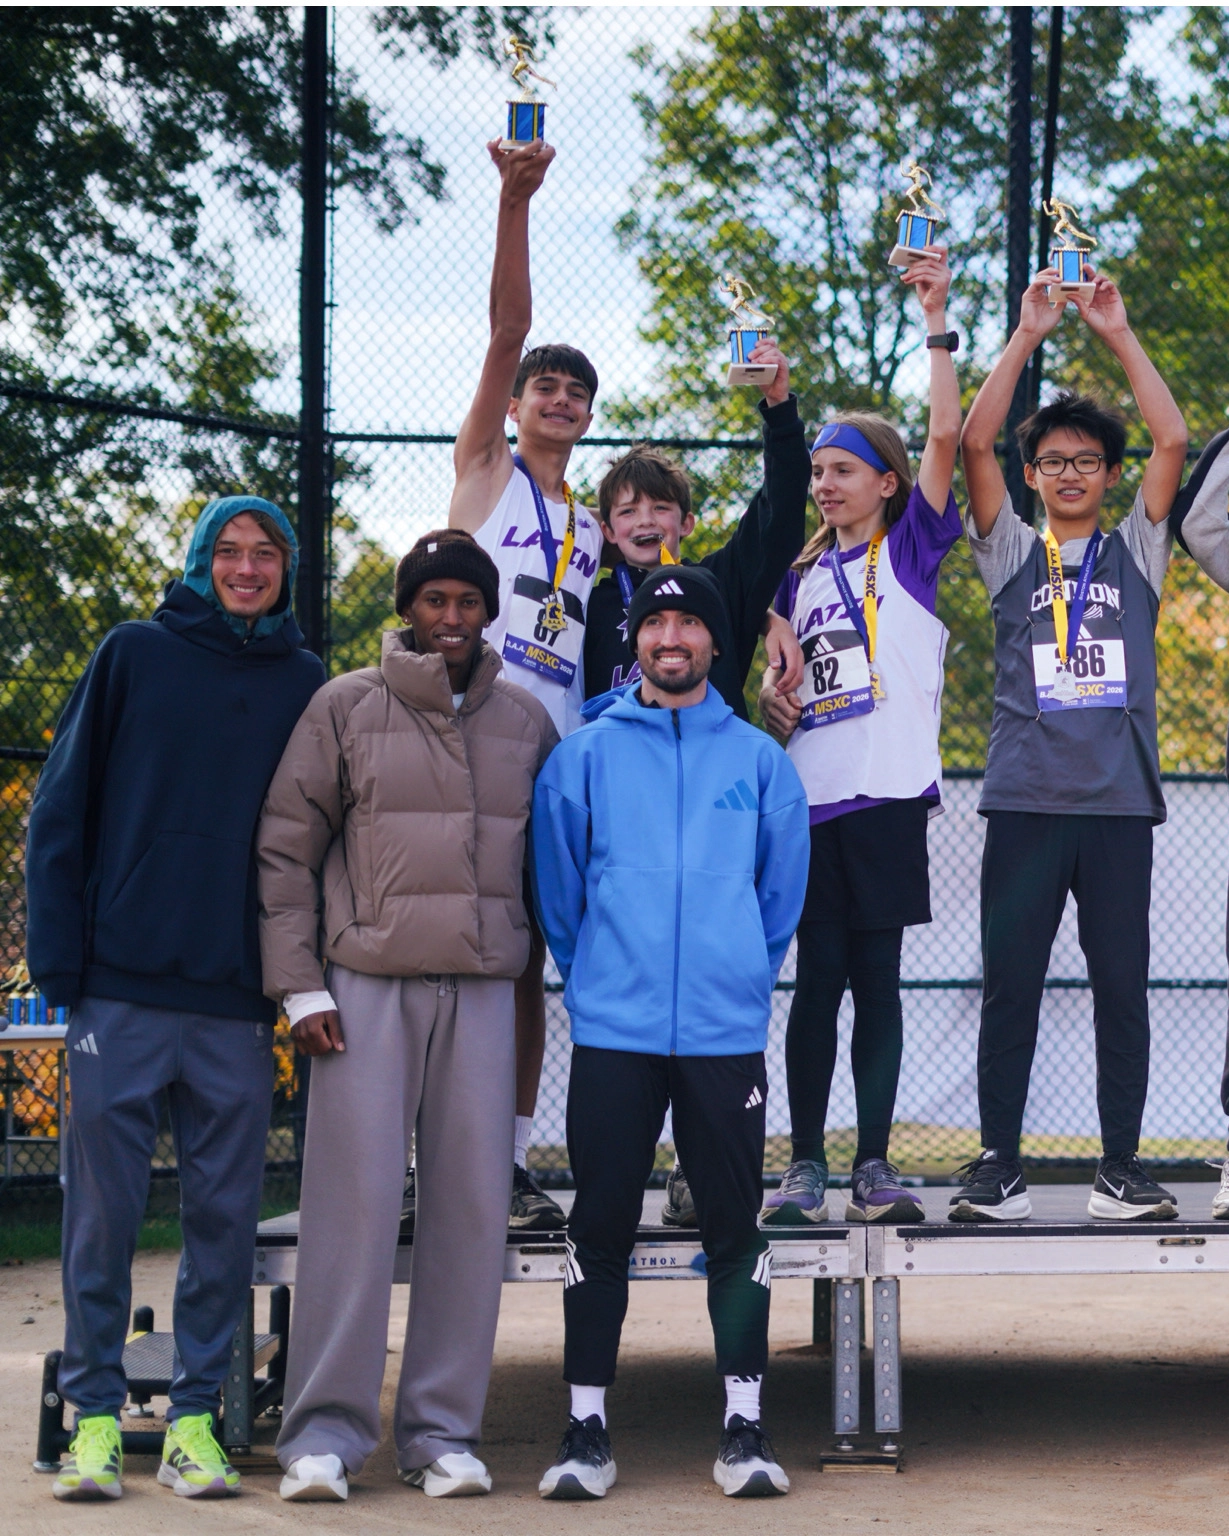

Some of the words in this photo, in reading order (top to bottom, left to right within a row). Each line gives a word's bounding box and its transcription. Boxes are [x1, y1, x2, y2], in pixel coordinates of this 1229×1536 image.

[870, 544, 878, 563] B.A.A.
[865, 564, 877, 599] MSXC
[1031, 579, 1120, 612] COON
[1050, 566, 1063, 600] MSXC
[1078, 582, 1087, 601] BOSTON
[1083, 563, 1091, 583] ATHLETIC
[506, 639, 525, 653] B.A.A.
[525, 645, 560, 669] MSXC
[560, 664, 573, 676] 2026
[812, 656, 843, 695] 82
[1077, 683, 1105, 697] SXC
[1106, 686, 1123, 694] 2026
[814, 694, 851, 715] MSXC
[852, 693, 869, 703] 2026
[630, 1257, 676, 1265] ATHON
